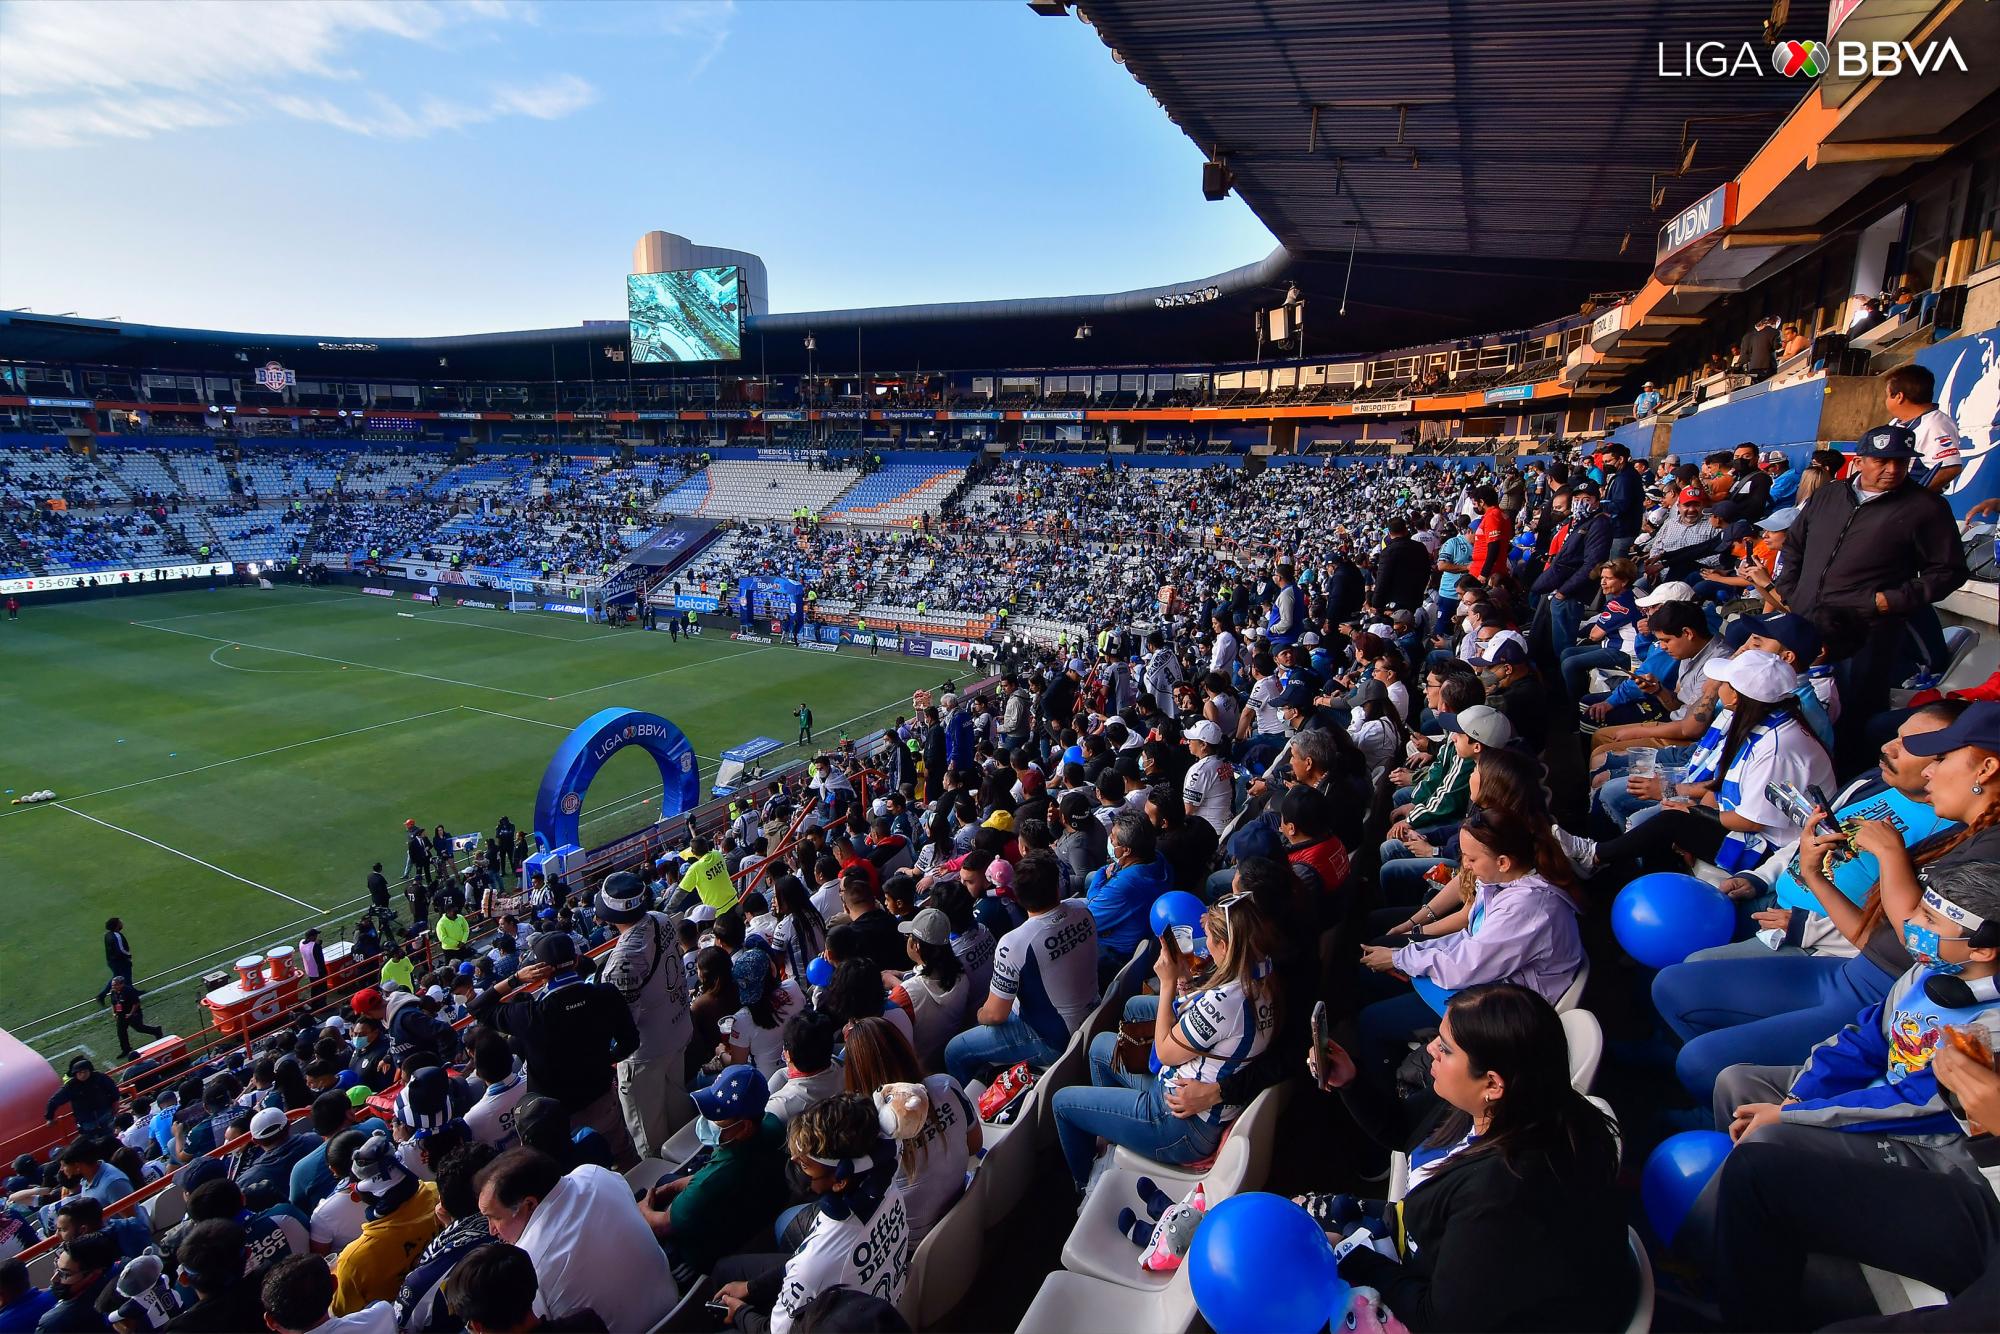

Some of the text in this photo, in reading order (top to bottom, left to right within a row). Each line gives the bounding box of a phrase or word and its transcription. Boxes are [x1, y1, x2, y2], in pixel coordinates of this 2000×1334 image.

[1667, 198, 1712, 251] TUDN
[1369, 403, 1396, 411] SPORTS
[246, 562, 287, 572] CARLY
[38, 574, 115, 589] 55-678-117
[463, 599, 496, 609] caliente.mx
[677, 596, 716, 612] betcris
[736, 634, 772, 644] caliente.mx
[853, 632, 898, 649] ROSHRANS
[594, 724, 668, 761] LIGA BBVA
[705, 860, 726, 881] STAFF
[443, 896, 453, 904] 75
[1044, 917, 1090, 950] Office
[1048, 925, 1093, 961] DEPOT
[247, 970, 258, 980] G
[565, 1000, 586, 1011] CHARLY
[1200, 997, 1227, 1024] UDN
[852, 1198, 902, 1268] Office
[857, 1210, 906, 1286] DEPOT
